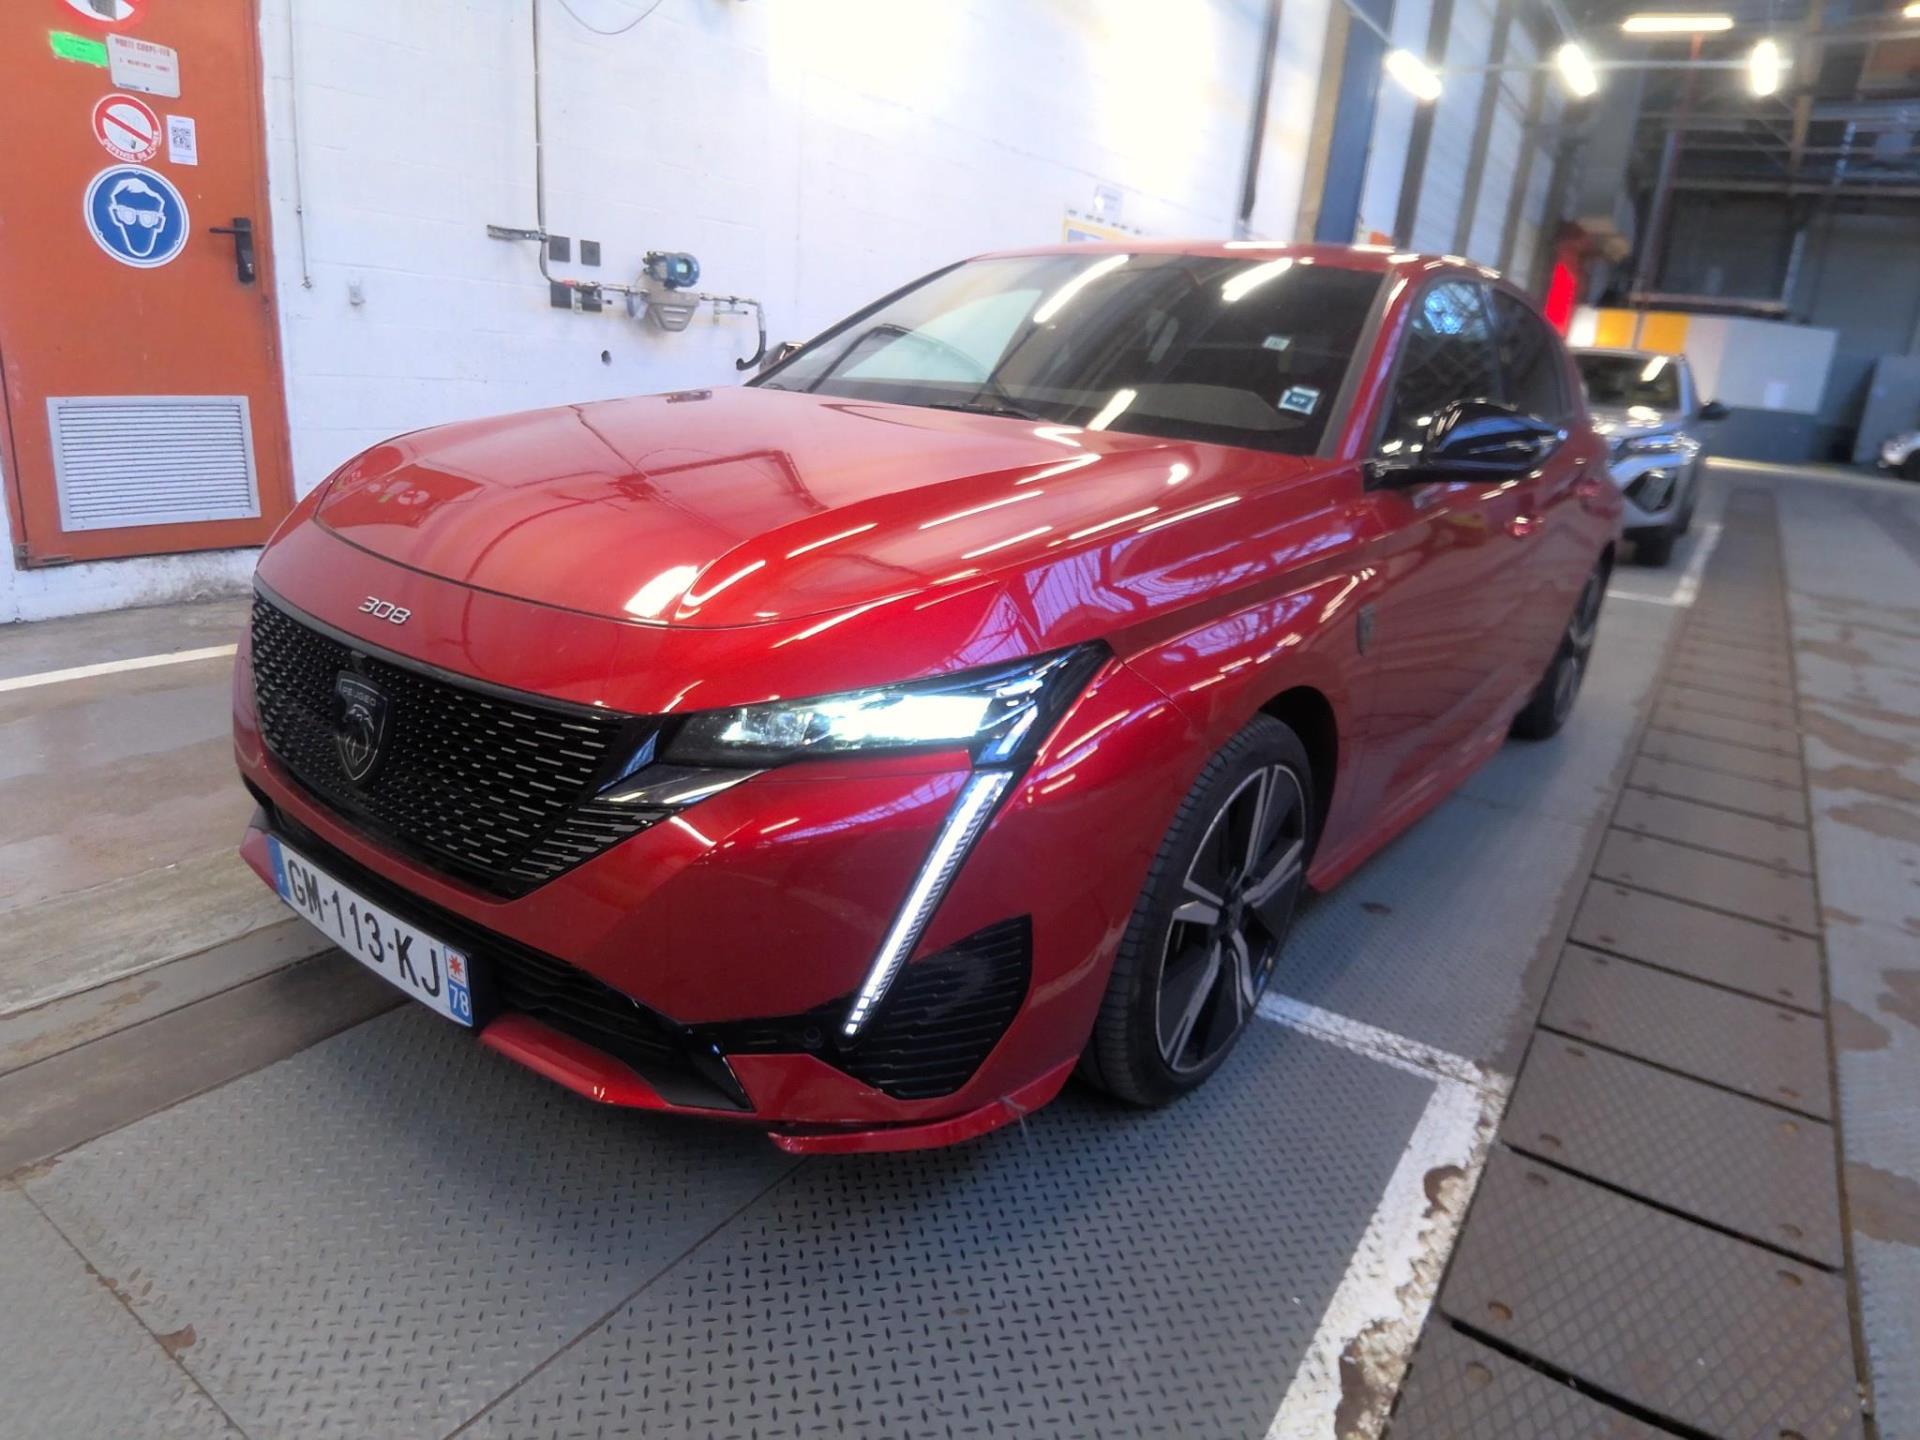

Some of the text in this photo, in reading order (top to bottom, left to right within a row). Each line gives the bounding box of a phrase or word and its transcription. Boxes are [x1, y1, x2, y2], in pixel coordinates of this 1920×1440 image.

[358, 596, 411, 624] 308
[342, 686, 378, 707] PEUGEO
[288, 859, 441, 998] GM-113-KJ
[449, 983, 470, 1017] 78
